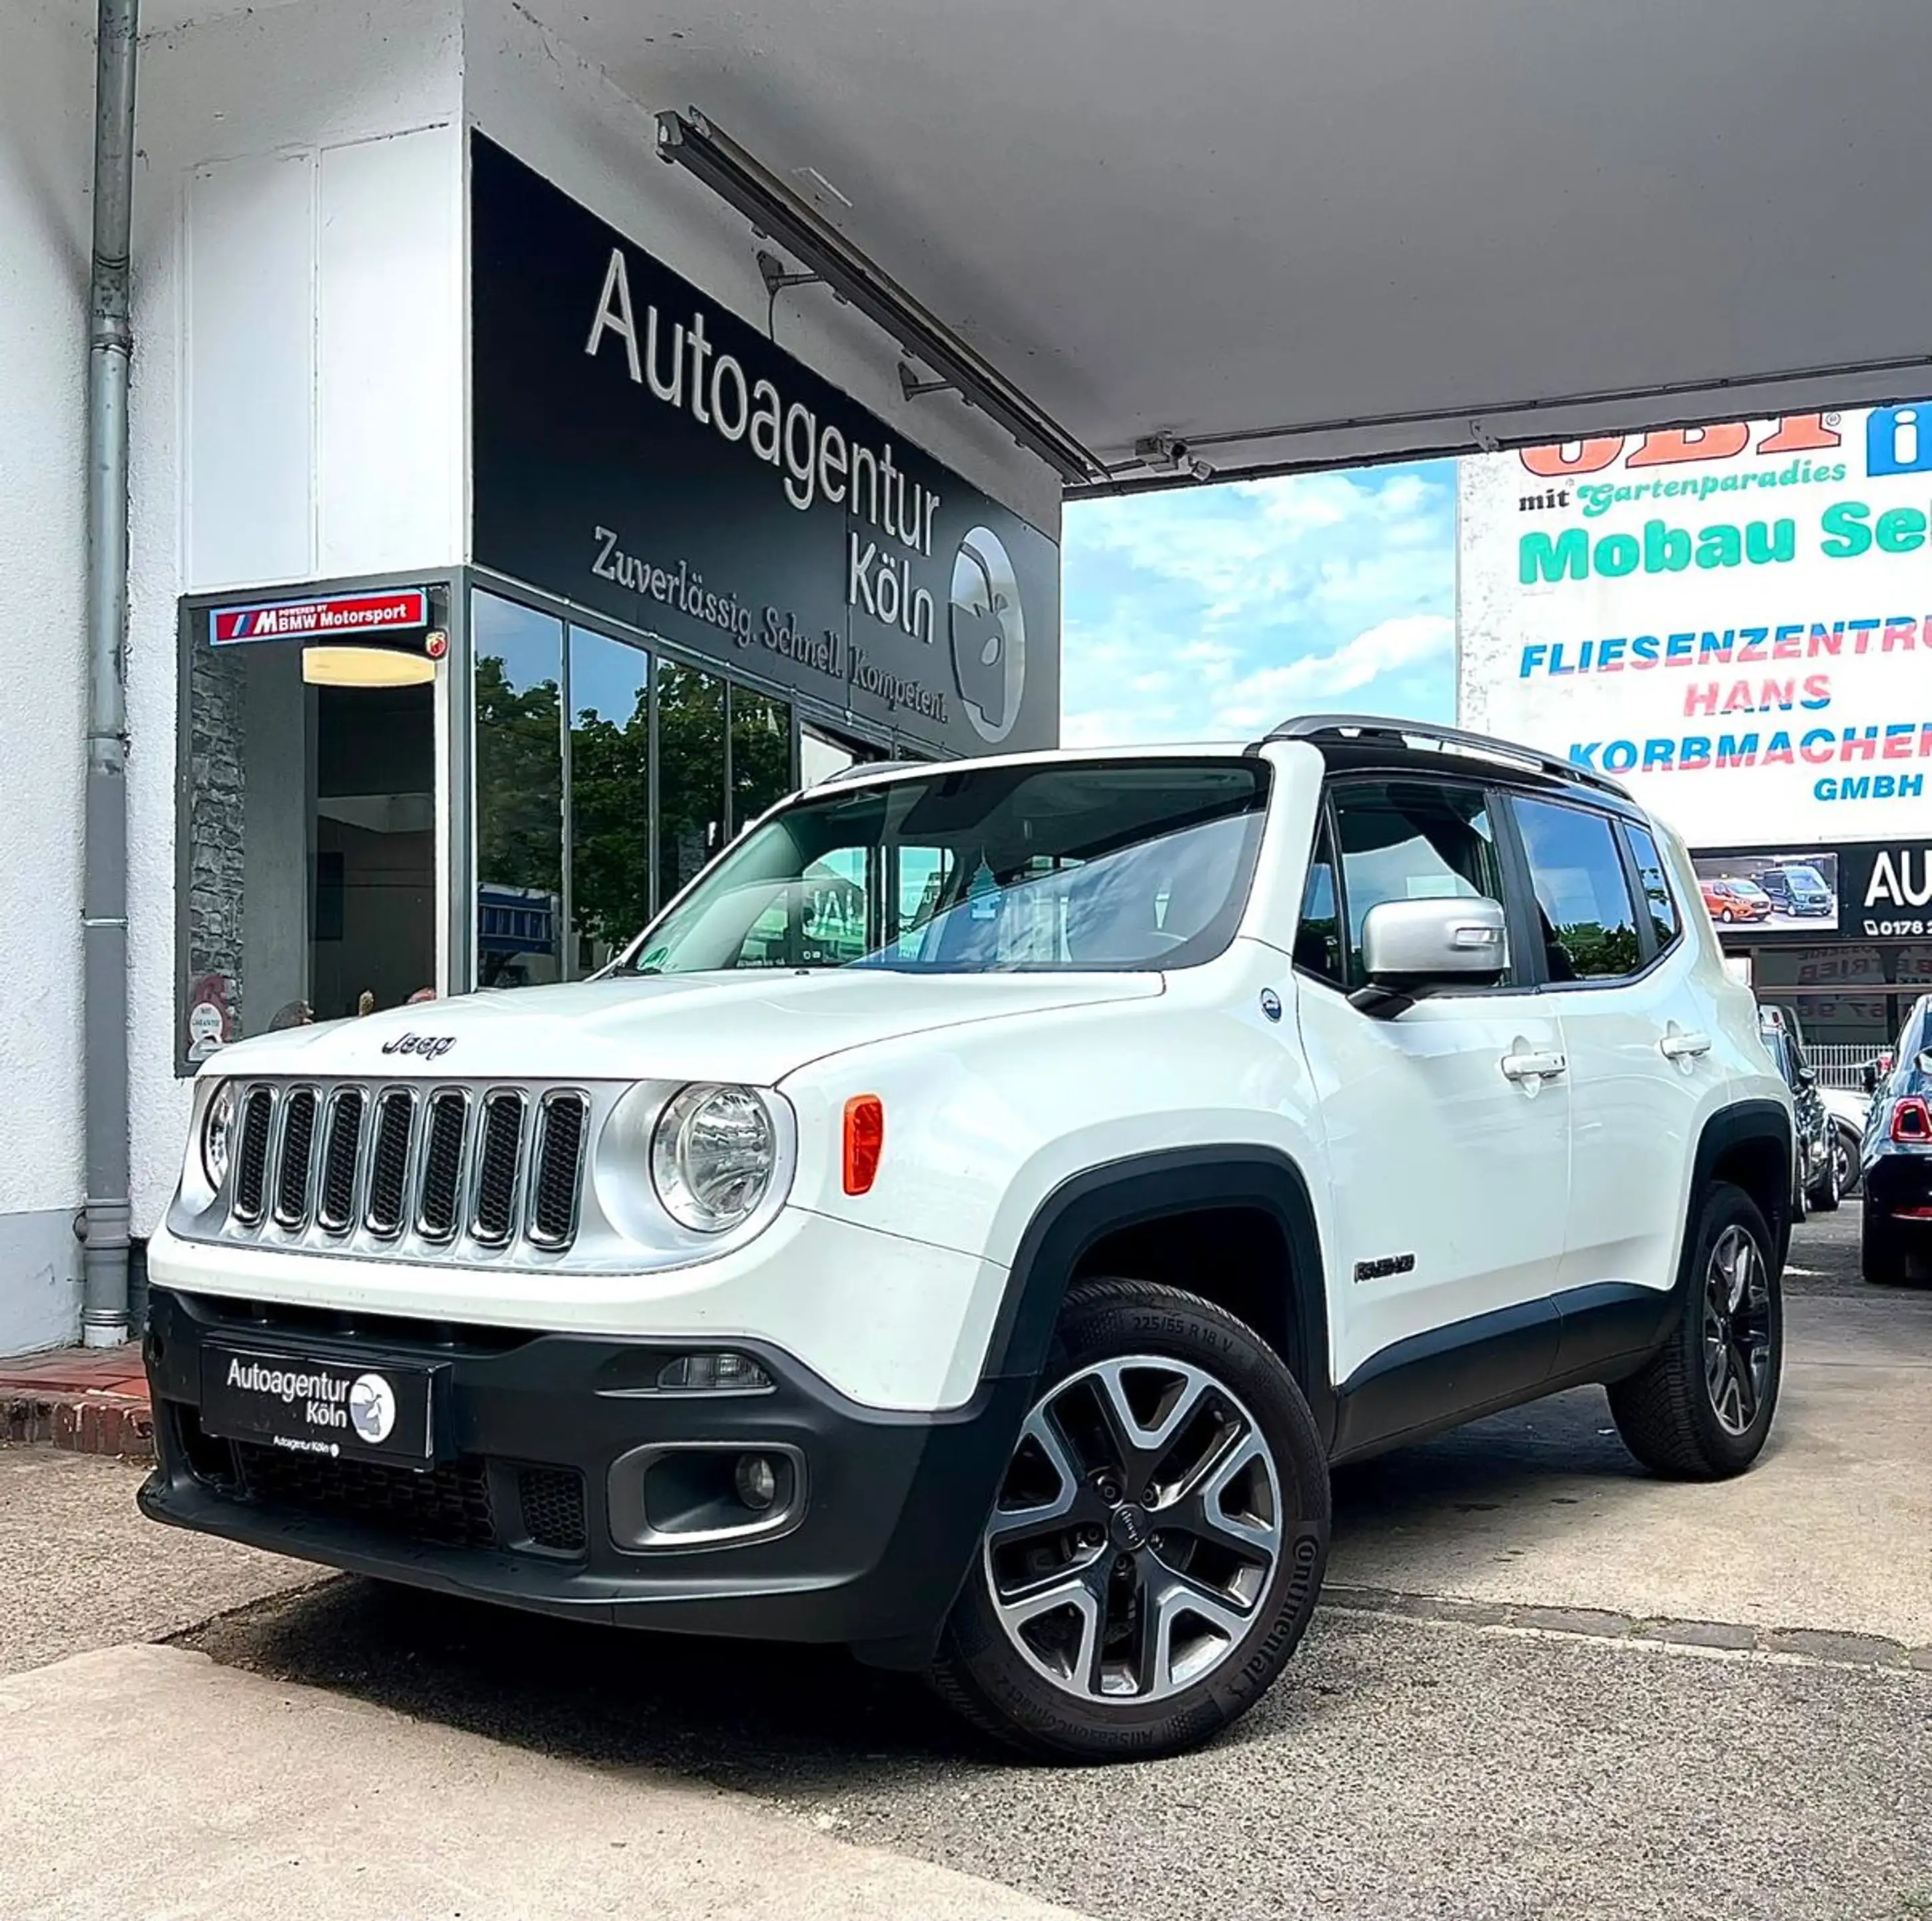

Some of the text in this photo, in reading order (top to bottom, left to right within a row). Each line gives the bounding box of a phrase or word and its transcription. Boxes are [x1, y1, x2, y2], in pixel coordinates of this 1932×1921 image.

[584, 248, 940, 557] Autoagentur
[1519, 462, 1846, 518] mit Gartenparadies
[1518, 499, 1932, 584] Mobau Se
[849, 532, 935, 645] Köln
[279, 606, 316, 616] POWERED
[279, 604, 407, 630] BMW Motorsport
[591, 525, 949, 724] Zuverlässig. Schnell. Kompetent.
[1682, 674, 1832, 716] HANS
[1814, 774, 1924, 801] GMBH
[1880, 920, 1923, 935] 0178
[381, 1033, 457, 1060] Jeep
[1134, 1316, 1184, 1333] 225/55
[1223, 1337, 1233, 1352] V
[227, 1358, 350, 1403] Autoagentur
[306, 1401, 347, 1428] Köln
[1240, 1535, 1319, 1685] Continental
